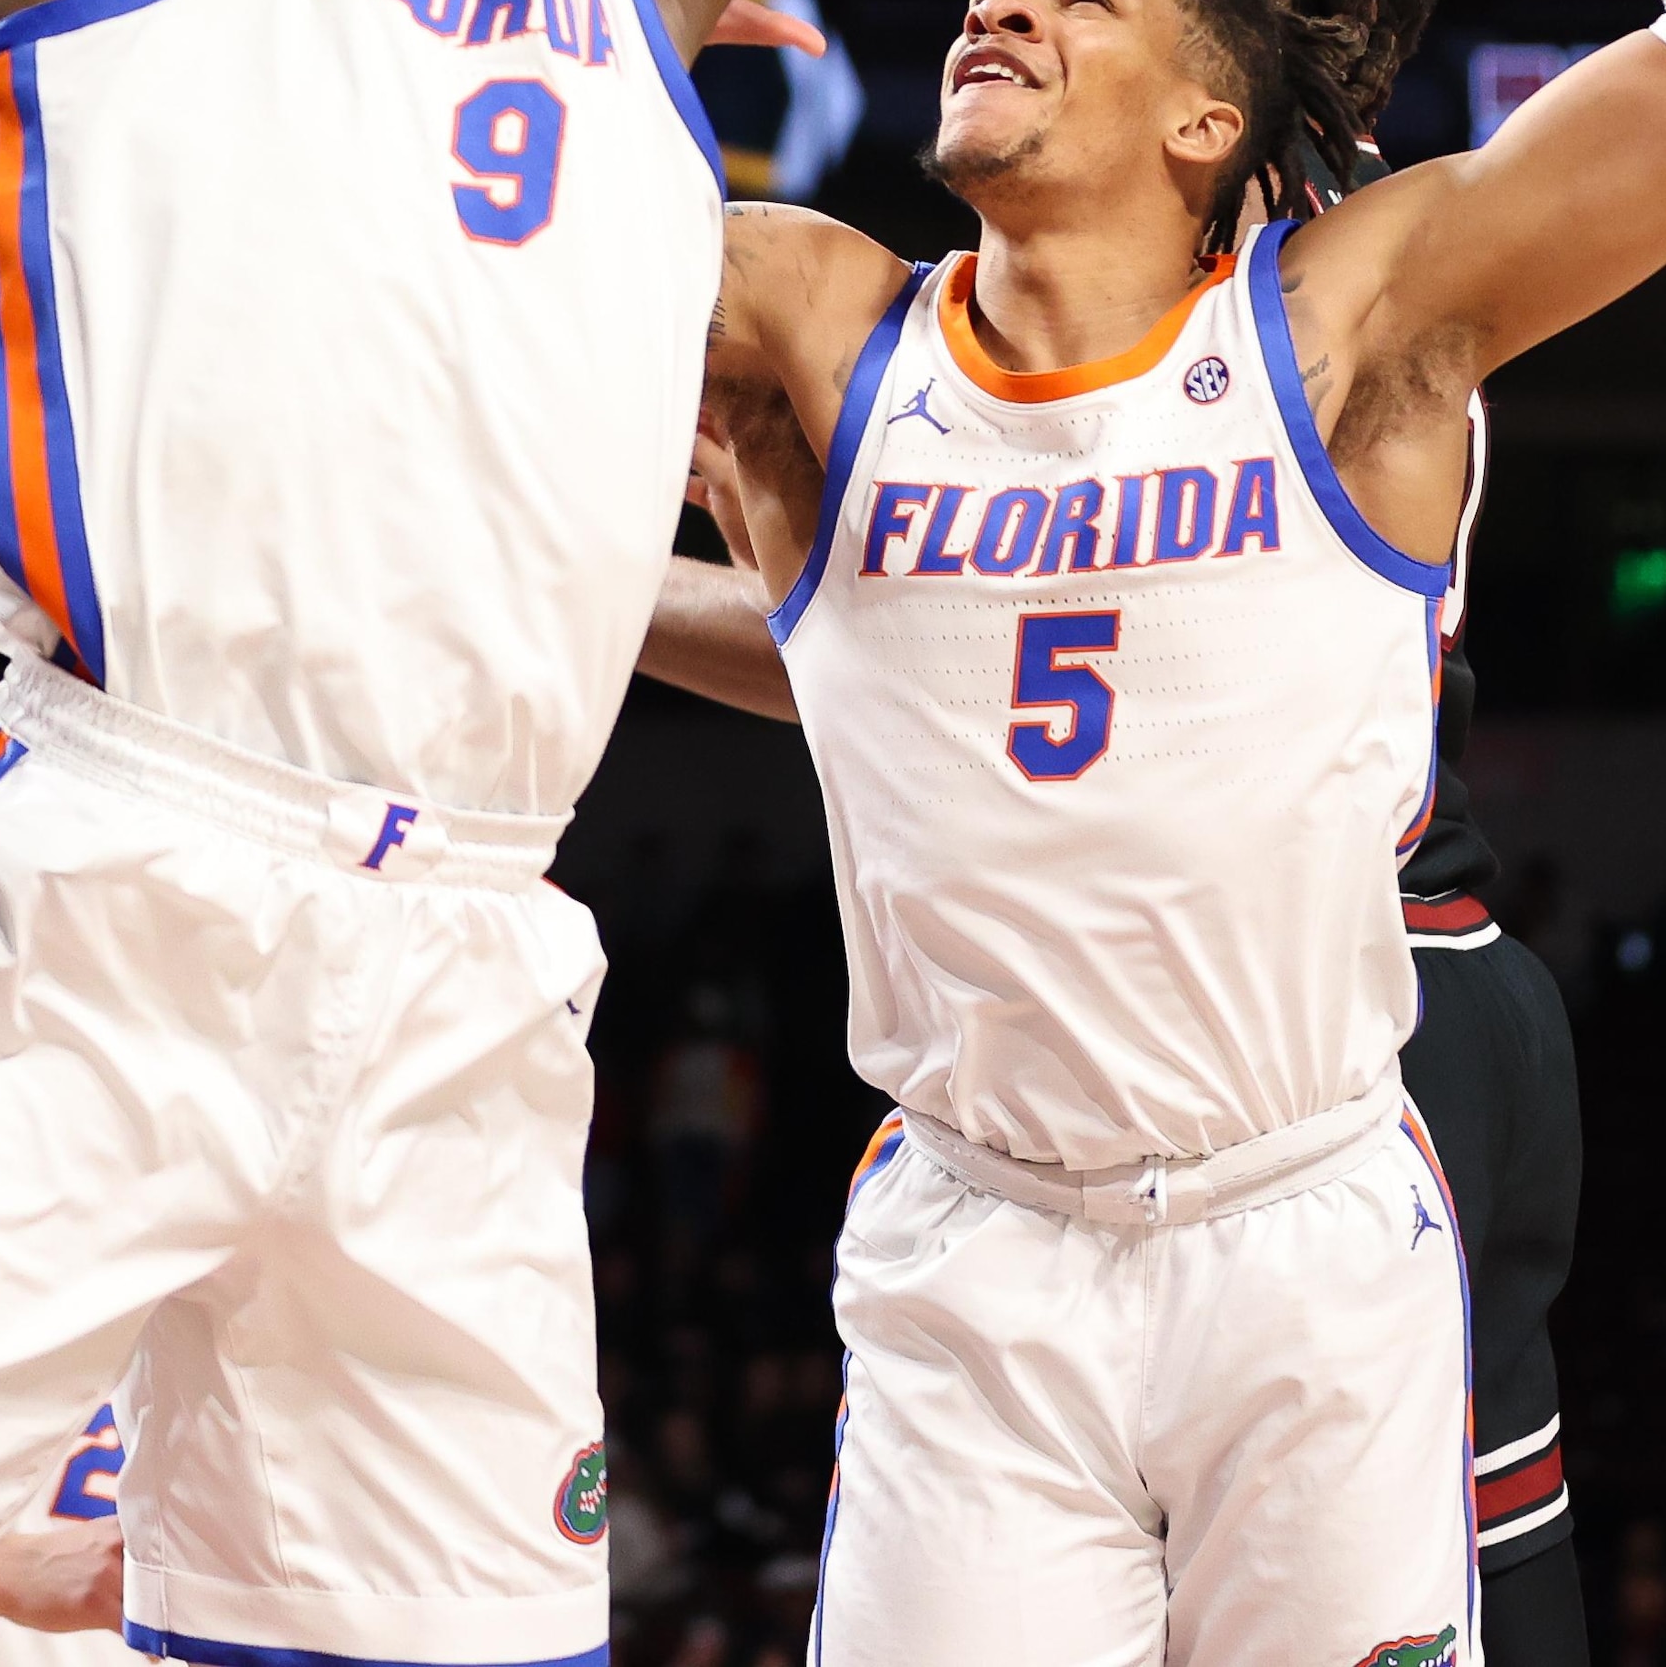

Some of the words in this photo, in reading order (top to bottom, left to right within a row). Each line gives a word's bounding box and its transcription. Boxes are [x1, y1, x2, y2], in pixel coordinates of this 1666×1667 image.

[449, 78, 568, 248] 9
[1185, 356, 1229, 404] SEC
[858, 455, 1281, 578] FLORIDA
[1006, 608, 1122, 782] 5
[357, 802, 420, 872] F
